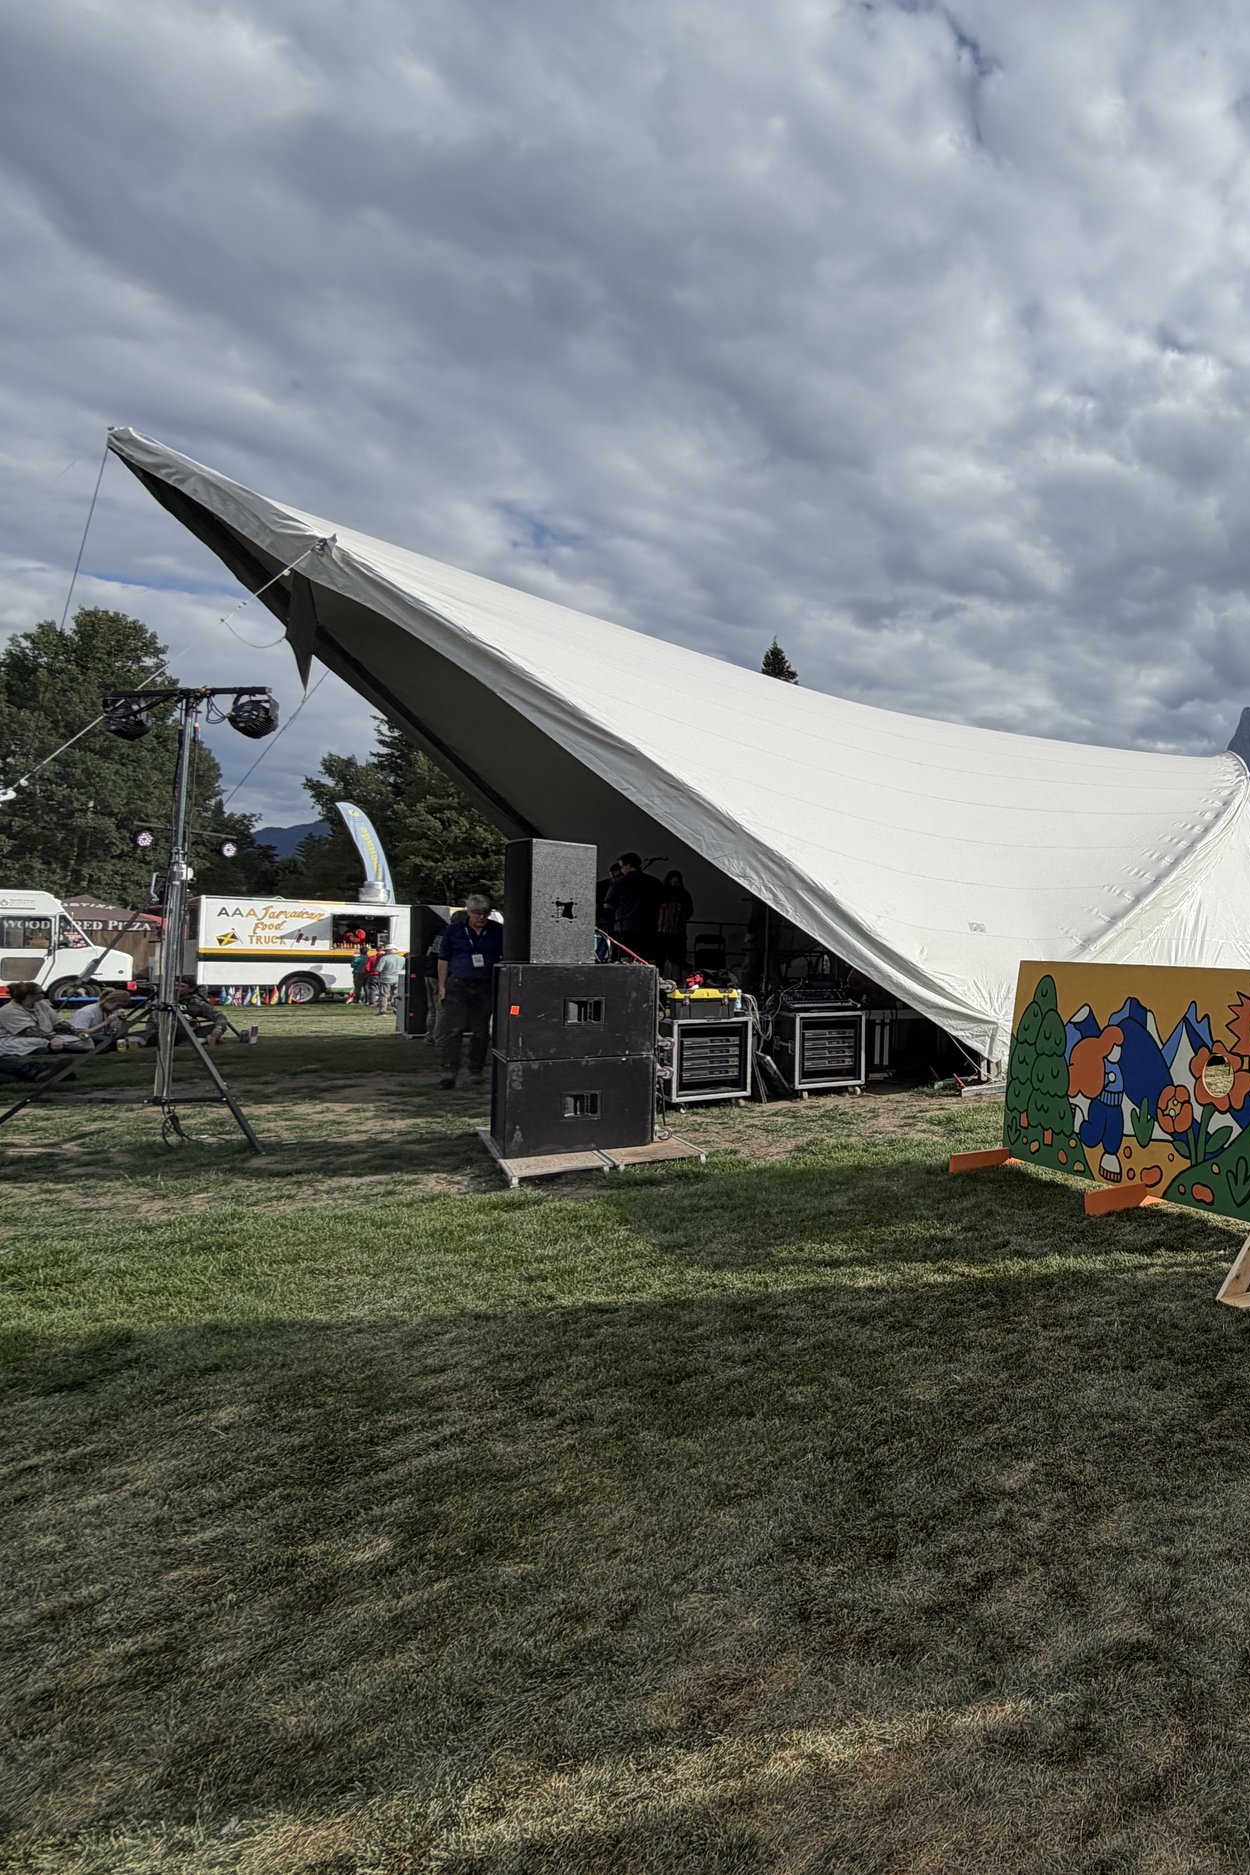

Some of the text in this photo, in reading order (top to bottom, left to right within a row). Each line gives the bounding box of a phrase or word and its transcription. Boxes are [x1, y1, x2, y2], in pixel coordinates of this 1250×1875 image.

[257, 905, 325, 921] Jamaican
[252, 920, 287, 935] Food
[248, 934, 287, 945] TRUCK
